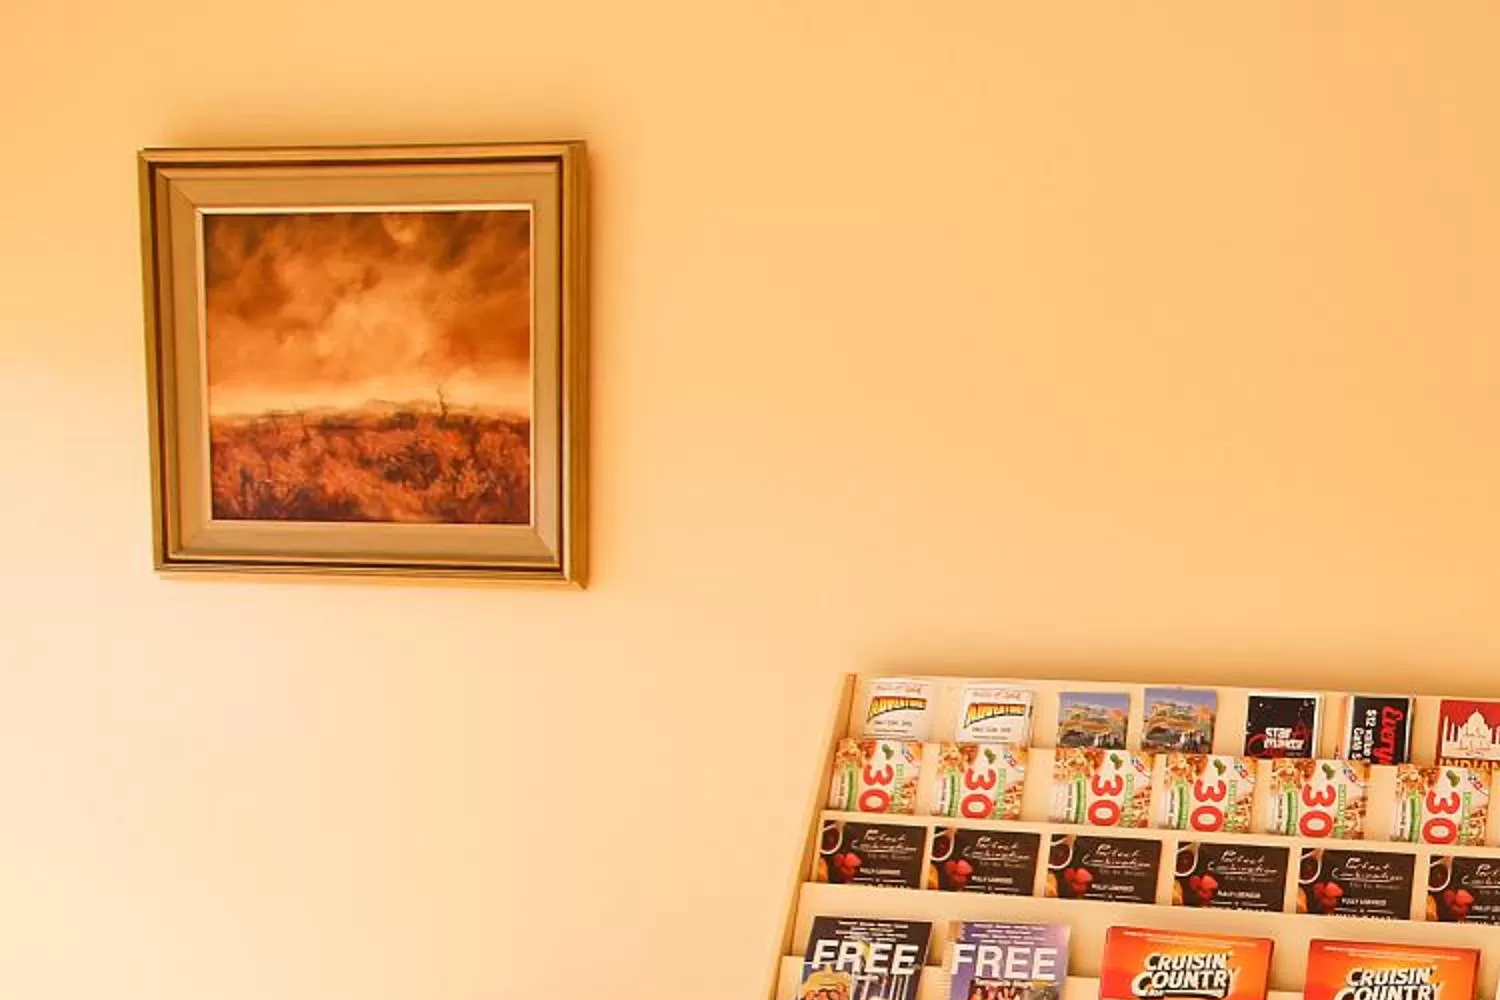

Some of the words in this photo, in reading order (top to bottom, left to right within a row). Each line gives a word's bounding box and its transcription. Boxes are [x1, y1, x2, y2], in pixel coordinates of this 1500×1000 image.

[858, 764, 894, 812] 30
[961, 768, 996, 819] 30
[1088, 774, 1123, 826] 30
[1190, 779, 1226, 832] 30
[1299, 784, 1336, 838] 30
[1422, 790, 1460, 844] 30
[811, 939, 919, 975] FREE
[950, 943, 1058, 980] FREE
[1131, 966, 1241, 999] COUNTRY
